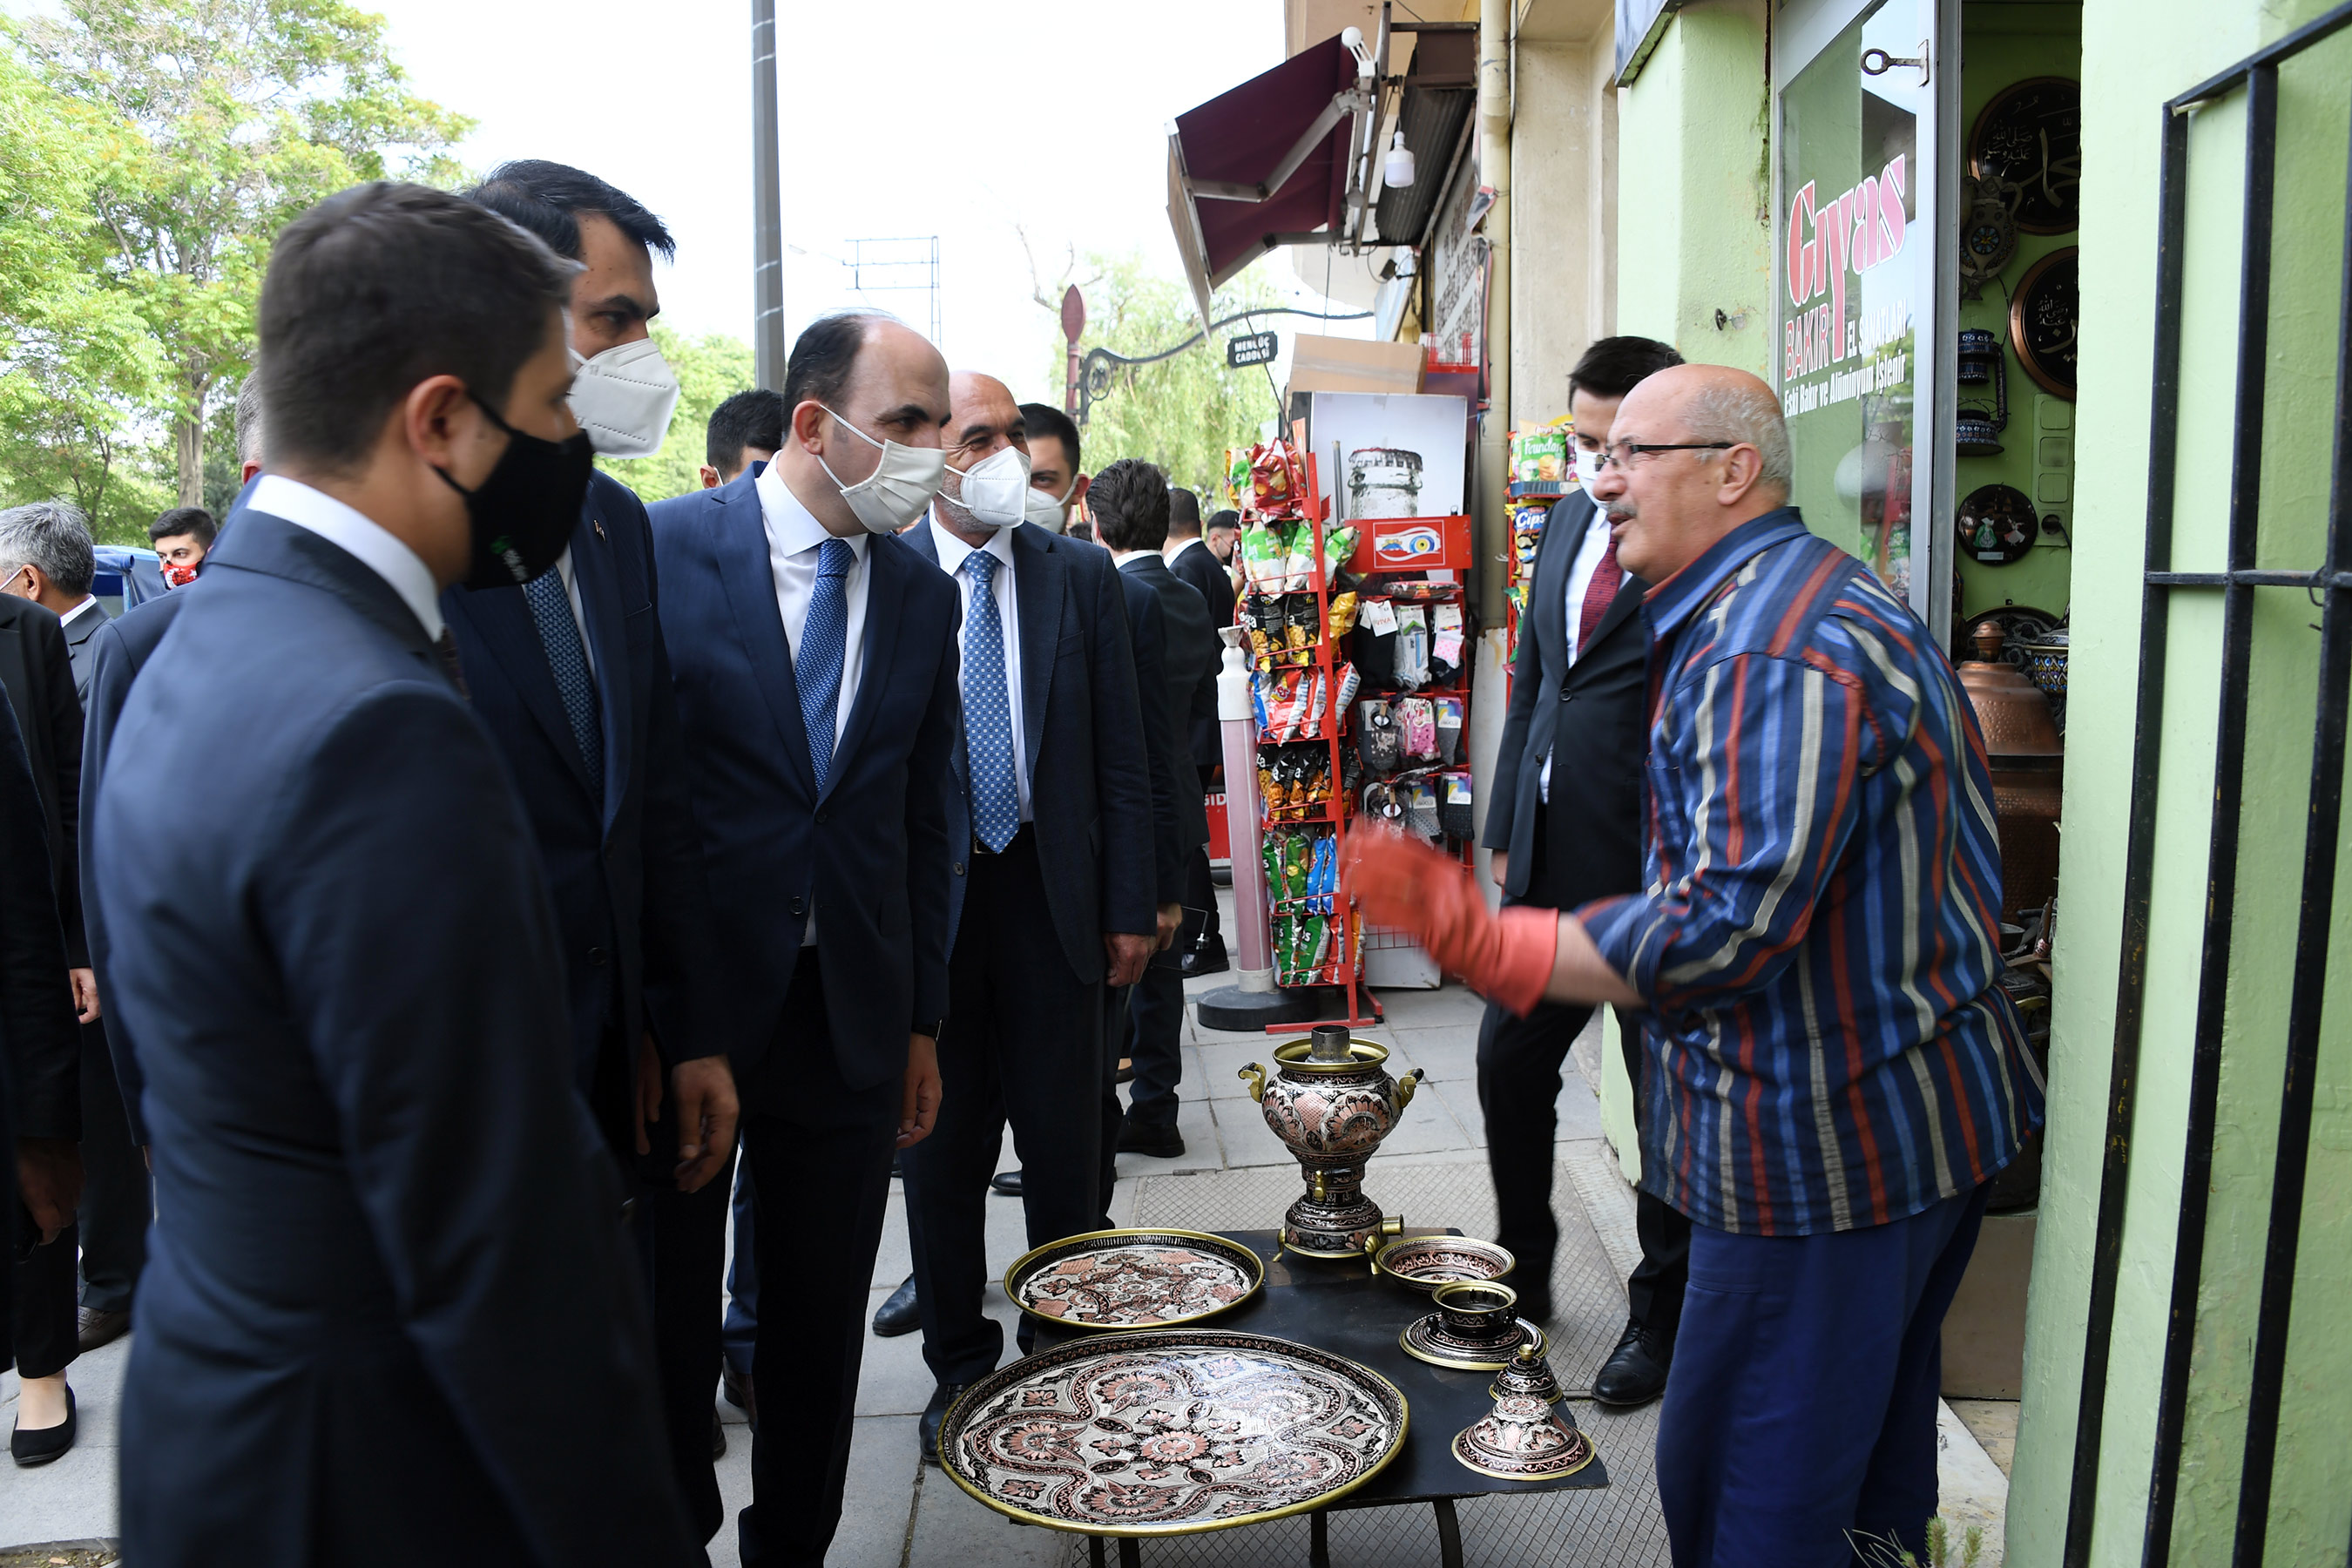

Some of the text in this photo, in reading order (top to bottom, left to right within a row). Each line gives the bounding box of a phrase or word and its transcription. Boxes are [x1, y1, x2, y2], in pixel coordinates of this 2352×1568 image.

[1785, 302, 1829, 382] BAKIR
[1847, 320, 1857, 359] EL
[1784, 386, 1799, 418] Eski
[1819, 381, 1828, 408] ve
[1829, 366, 1875, 405] Alüminyum
[1876, 348, 1906, 395] İşlenir
[1516, 511, 1546, 530] Cips
